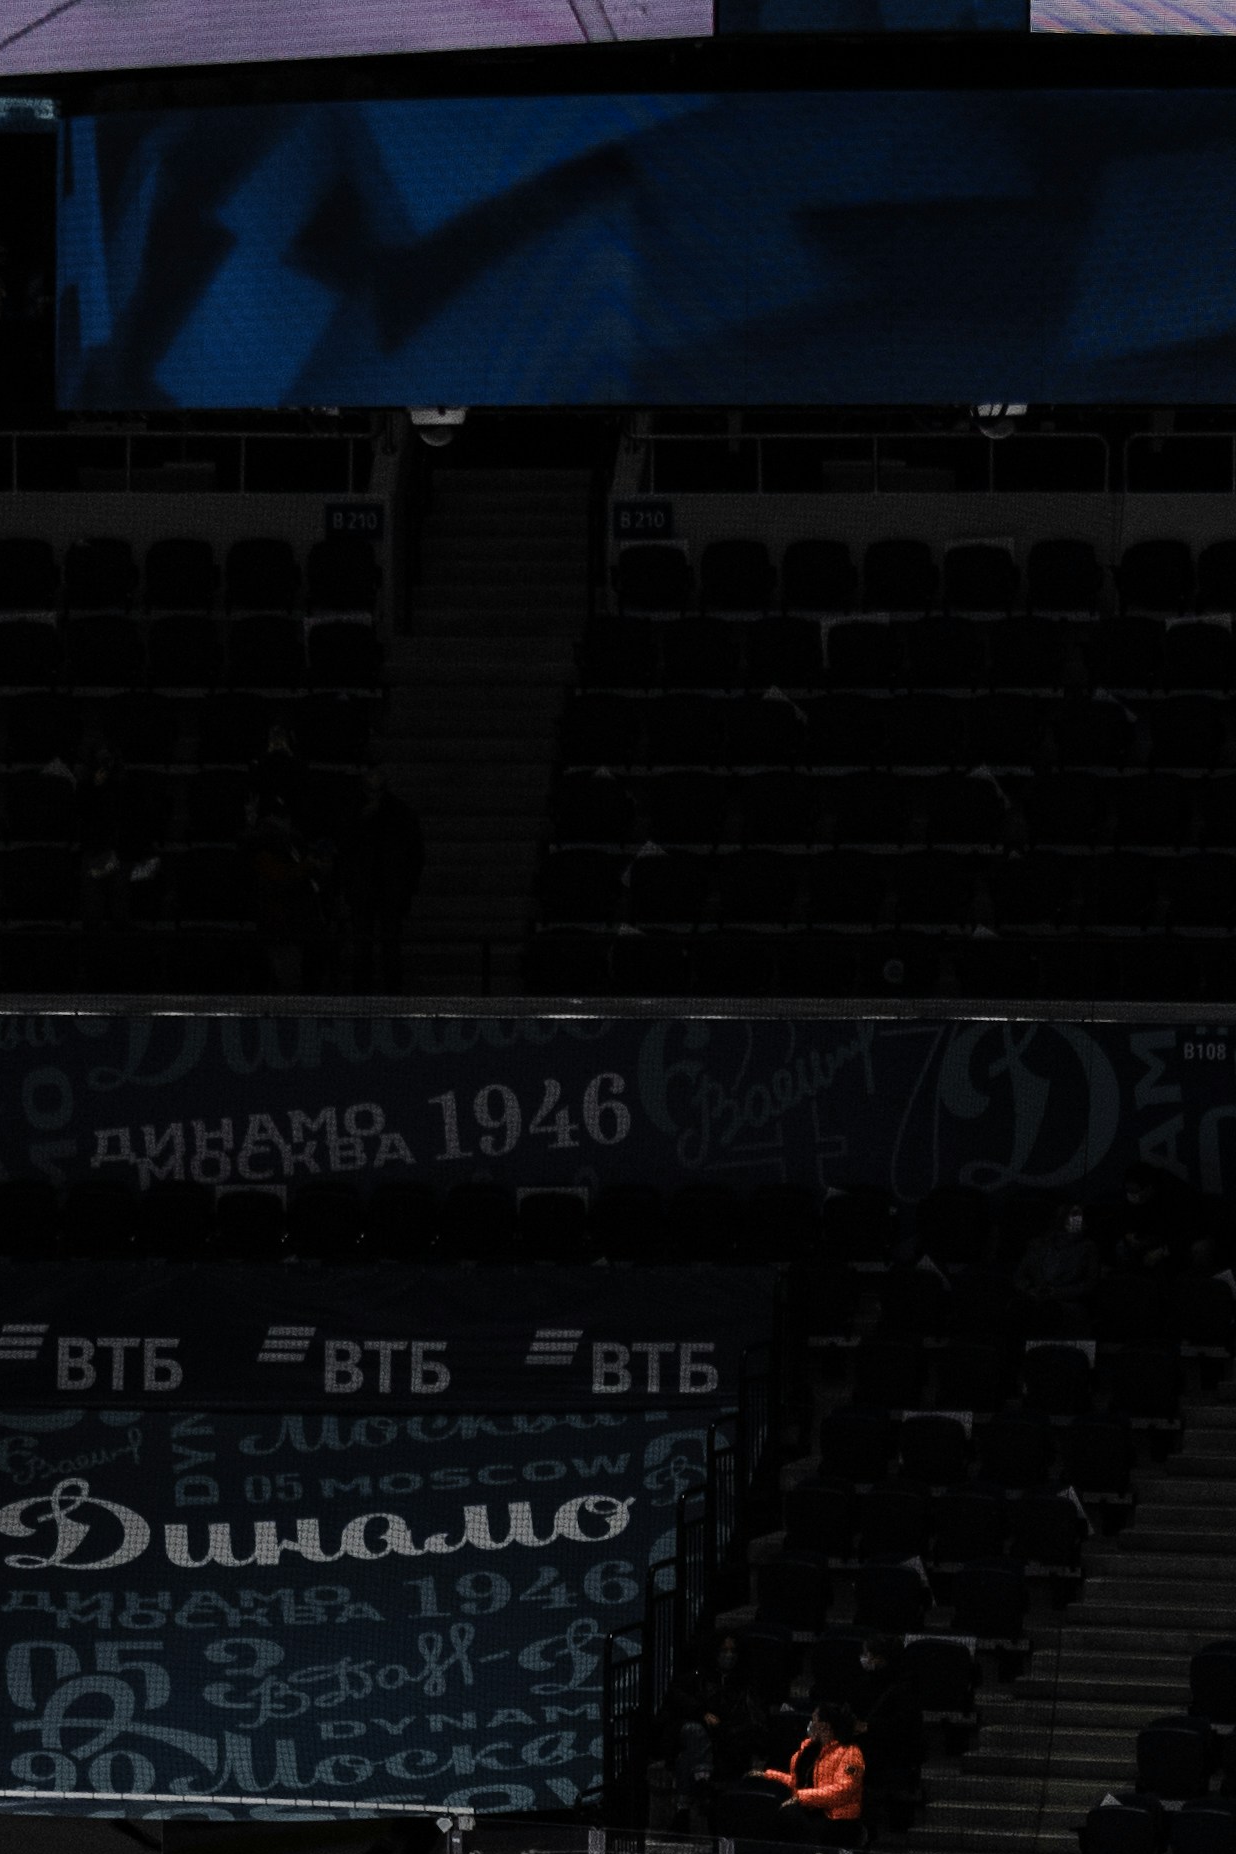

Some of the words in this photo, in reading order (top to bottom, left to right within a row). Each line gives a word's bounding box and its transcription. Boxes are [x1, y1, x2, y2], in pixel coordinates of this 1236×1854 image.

[1183, 1042, 1227, 1061] B108
[90, 1102, 387, 1169] ДИНАМО
[429, 1072, 632, 1162] 1946
[56, 1336, 184, 1393] ВТБ
[323, 1341, 452, 1395] ВТБ
[592, 1341, 720, 1395] ВТБ
[319, 1453, 632, 1498] MOSCOW
[403, 1560, 640, 1618] 1946
[318, 1703, 602, 1741] DYNAM
